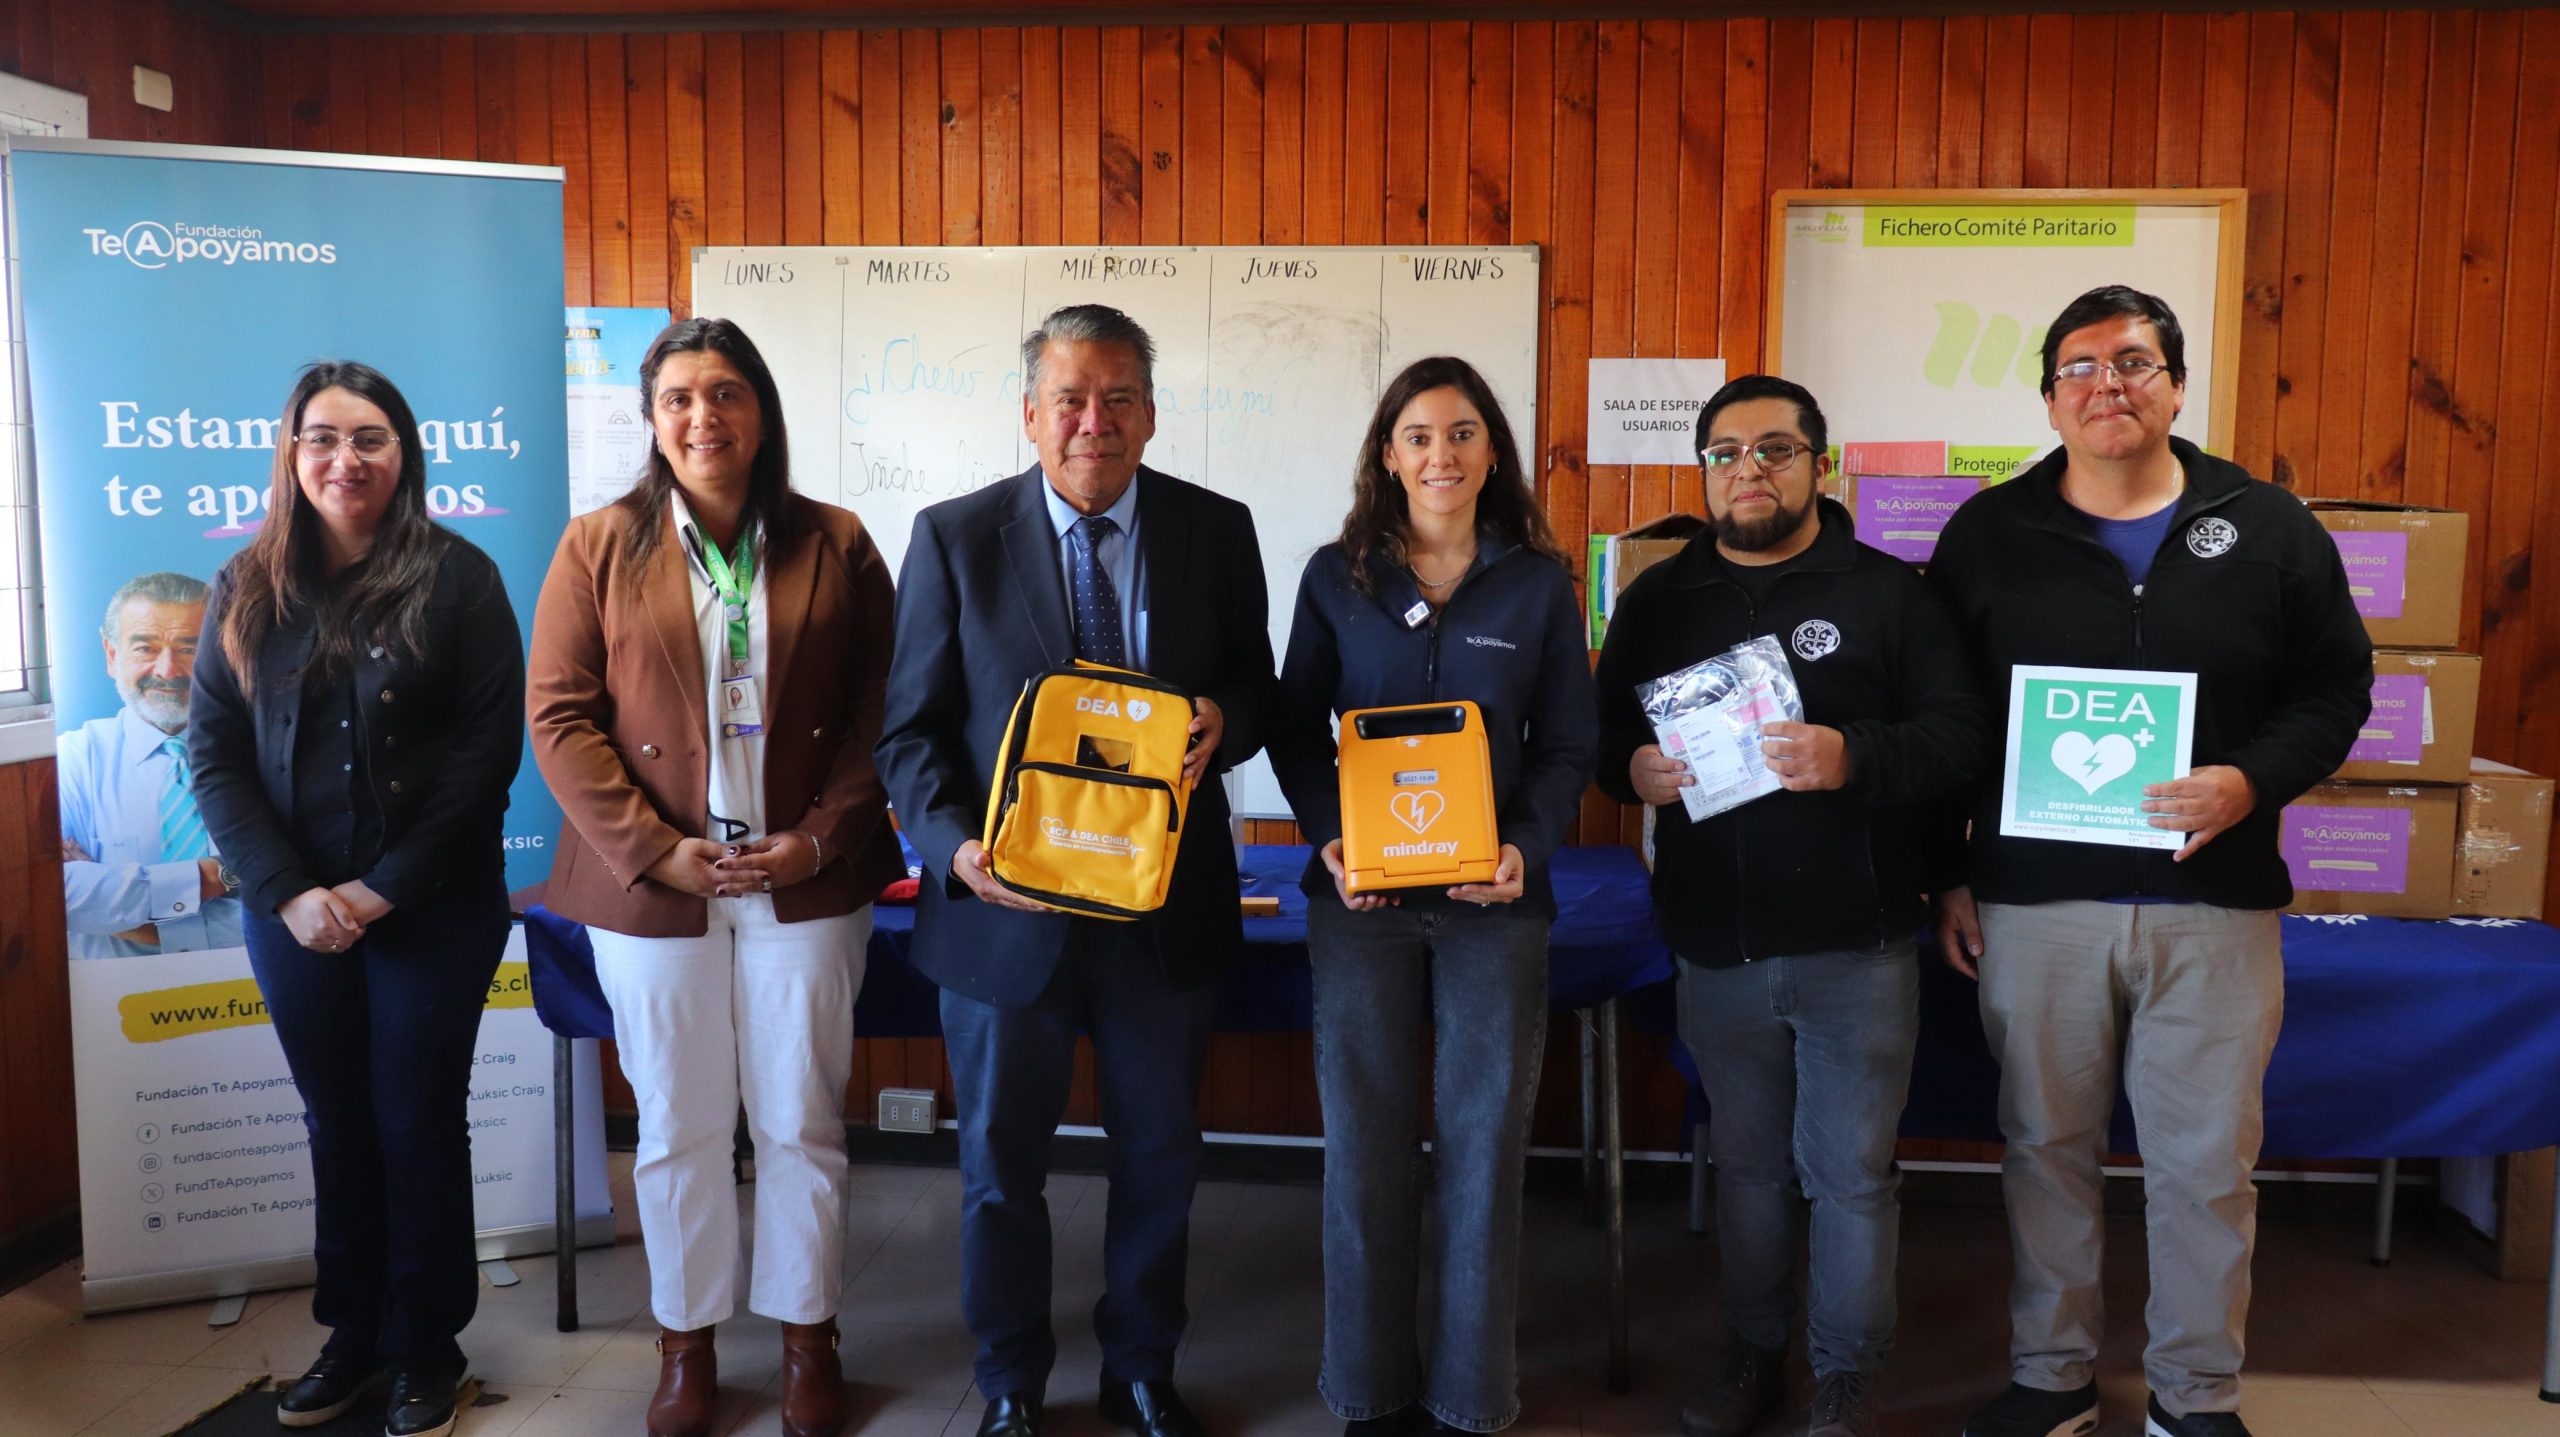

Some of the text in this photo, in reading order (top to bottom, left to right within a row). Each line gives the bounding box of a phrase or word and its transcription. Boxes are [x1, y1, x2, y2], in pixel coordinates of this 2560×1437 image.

[175, 222, 263, 239] Fundación
[1880, 217, 2116, 236] Fichero Comité Paritario
[724, 258, 794, 286] LUNES
[867, 259, 950, 286] MARTES
[1060, 254, 1177, 282] MIÉRCOLES
[1241, 257, 1318, 284] JUEVES
[1414, 256, 1504, 282] VIERNES
[1603, 399, 1636, 411] SALA
[1640, 400, 1657, 411] DE
[422, 405, 522, 464] quí,
[1623, 420, 1690, 432] USUARIOS
[1954, 457, 2020, 475] Protegie
[103, 475, 163, 517] te
[1076, 696, 1120, 718] DEA
[2046, 688, 2157, 725] DEA
[2029, 810, 2147, 828] EXTERNO AUTOMÁTIC
[2048, 801, 2135, 816] DESFIBRILADOR
[503, 835, 545, 850] KSIC
[1049, 826, 1131, 846] RCP & DEA CHILE
[1383, 840, 1459, 858] mindray
[482, 1052, 516, 1065] Craig
[136, 1075, 297, 1103] Fundación Te Apoyamo
[470, 1084, 545, 1101] Luksic Craig
[171, 1111, 306, 1136] Fundación Te Apoya
[470, 1117, 508, 1129] uksicc
[174, 1140, 311, 1165] fundacionteapoyam
[175, 1169, 295, 1195] FundTeApoyamos
[474, 1171, 513, 1185] Luksic
[177, 1197, 316, 1224] Fundación Te Apoya
